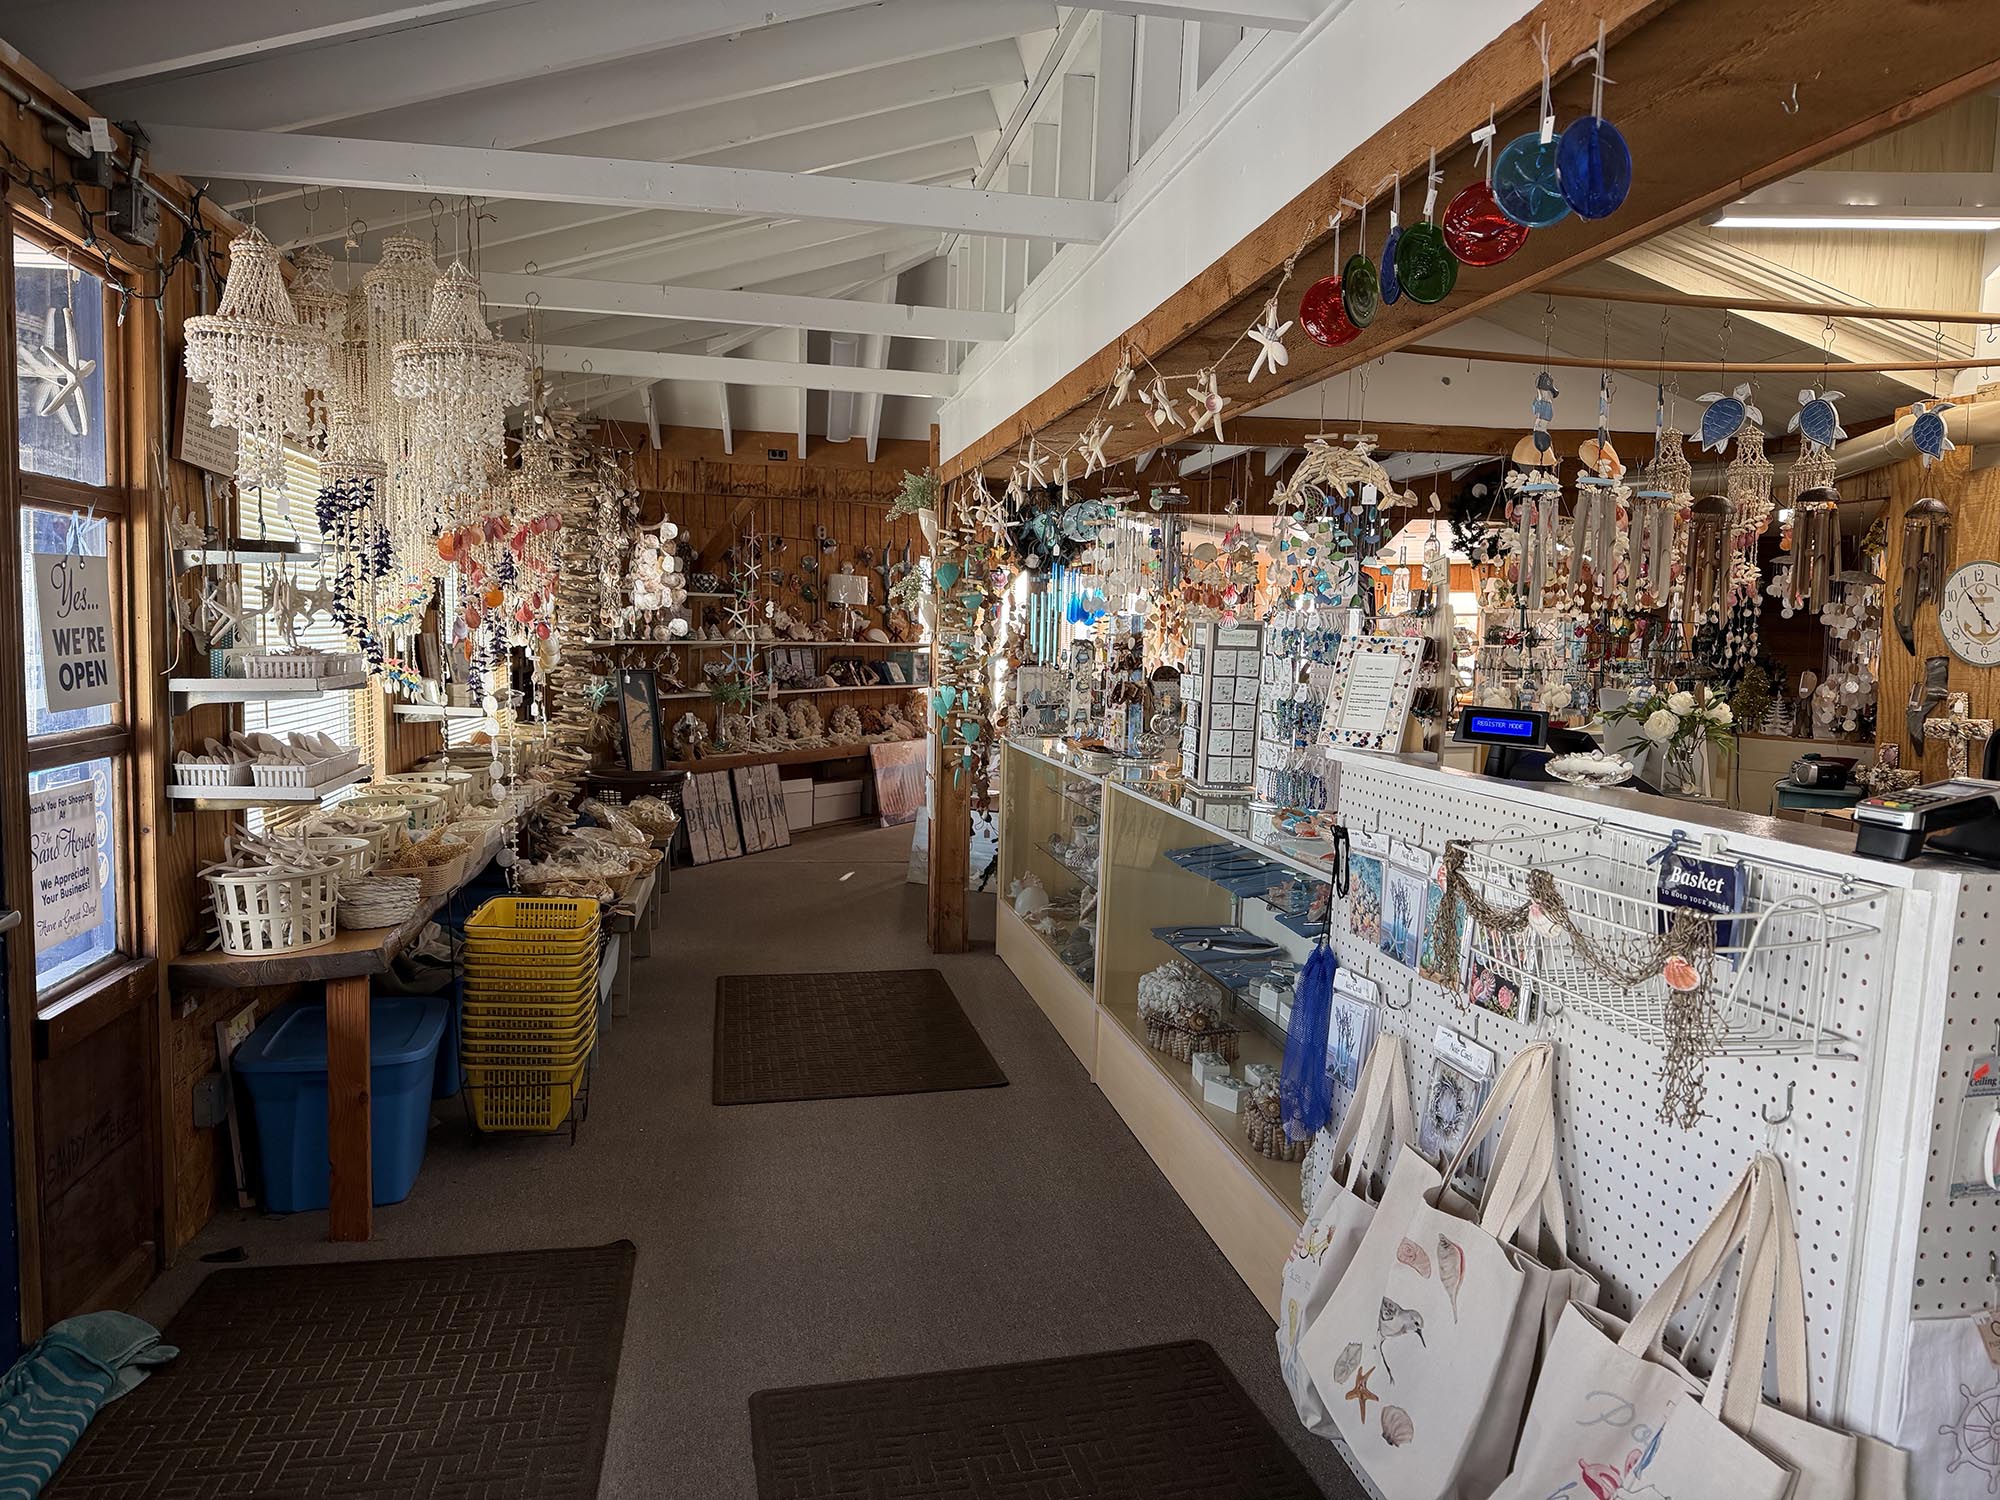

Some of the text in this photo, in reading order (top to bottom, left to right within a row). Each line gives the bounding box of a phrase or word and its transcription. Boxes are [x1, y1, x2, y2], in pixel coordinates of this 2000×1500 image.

[1960, 576, 1967, 588] 11
[1974, 569, 1984, 582] 12
[51, 563, 99, 618] Yes...
[1948, 590, 1958, 602] 10
[1945, 610, 1952, 622] 9
[52, 626, 106, 656] WE'RE
[1952, 628, 1960, 640] 8
[1964, 642, 1970, 654] 7
[1981, 646, 1989, 658] 6
[59, 659, 108, 691] OPEN
[1477, 720, 1506, 728] REGISTER
[30, 792, 93, 815] hank You For Shopping
[59, 810, 66, 820] At
[741, 794, 785, 822] OCEAN
[686, 802, 735, 833] BEACH
[31, 827, 96, 872] Sand House
[40, 866, 90, 891] We Appreciate
[1669, 865, 1725, 894] Basket
[41, 878, 90, 906] Your Business!
[1689, 896, 1707, 905] YOUR
[36, 919, 57, 937] Have
[62, 908, 81, 930] Great
